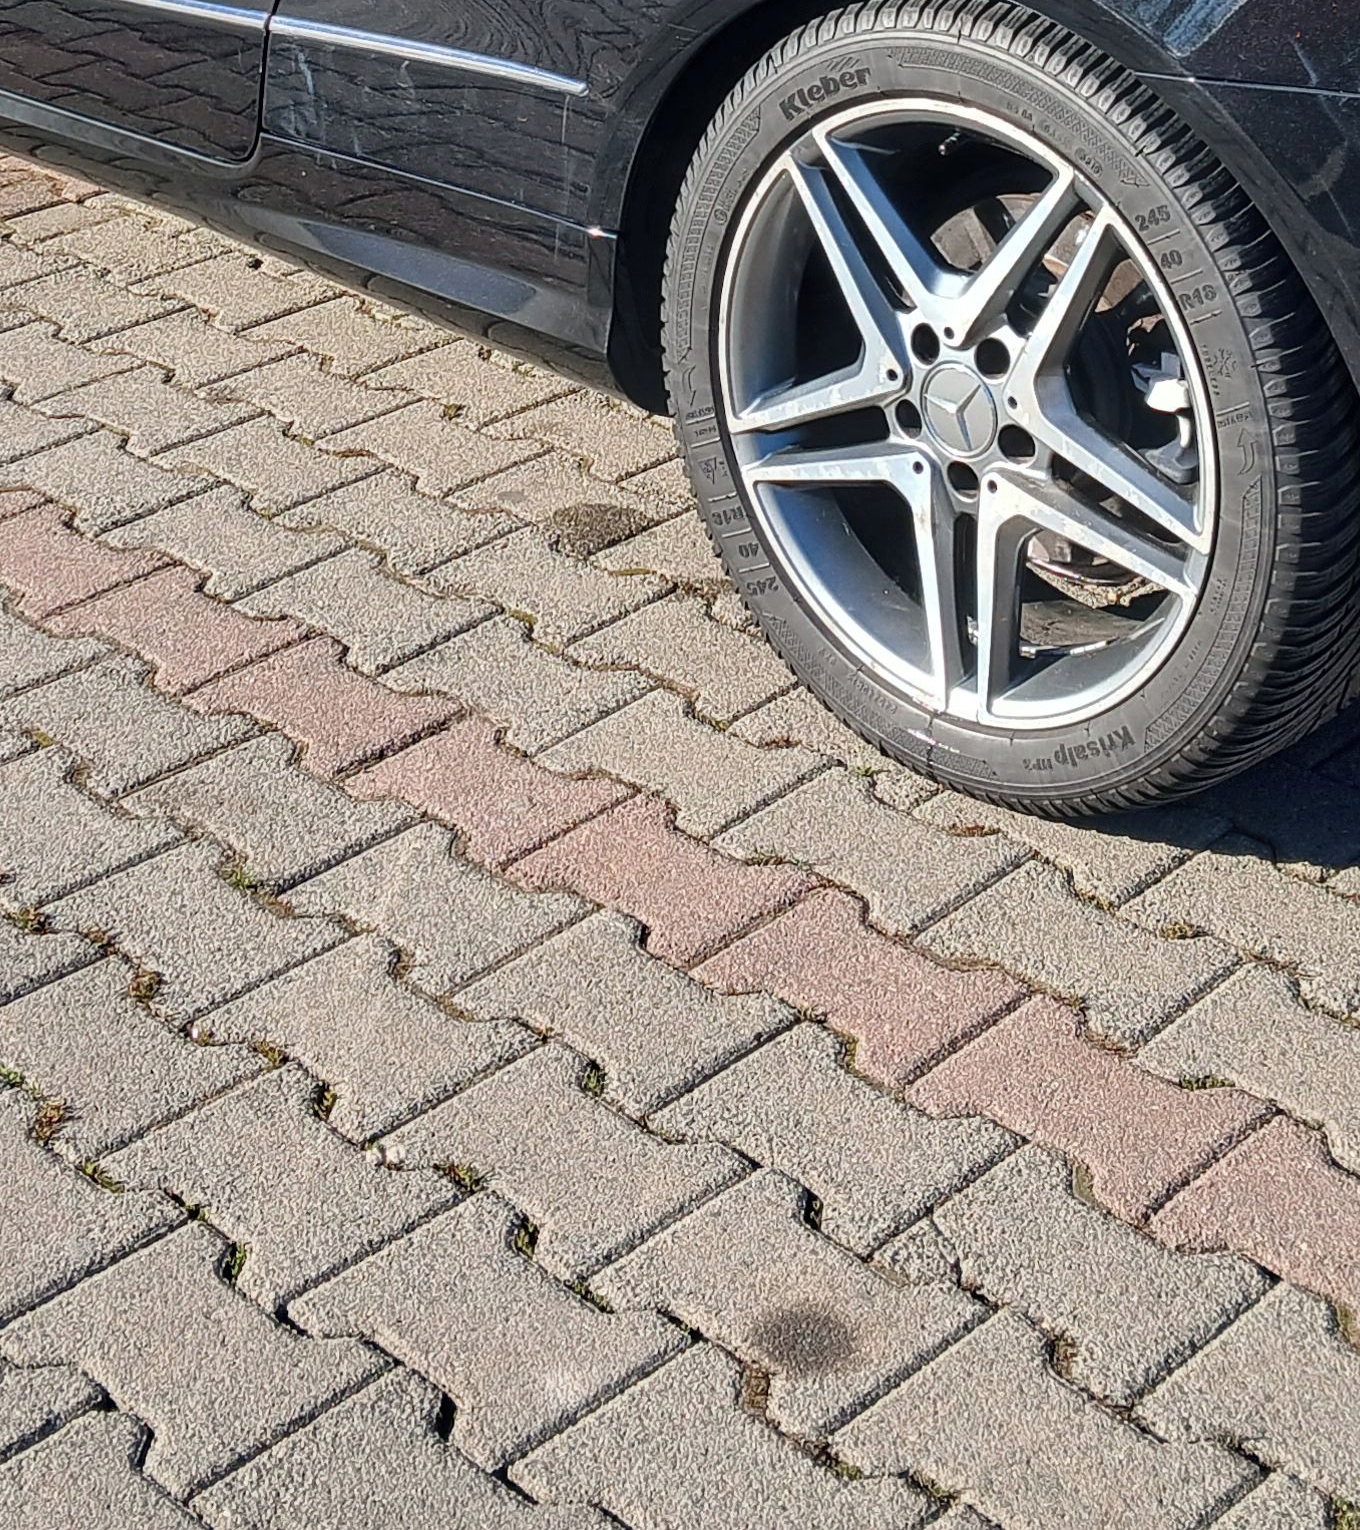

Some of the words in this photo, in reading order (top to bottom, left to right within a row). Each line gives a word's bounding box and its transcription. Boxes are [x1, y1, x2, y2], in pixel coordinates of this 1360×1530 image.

[779, 67, 871, 121] Kleber
[1135, 205, 1171, 232] 245
[1160, 250, 1183, 269] 40
[739, 543, 759, 558] 40
[747, 577, 779, 596] 245
[1053, 725, 1135, 767] Krisalp
